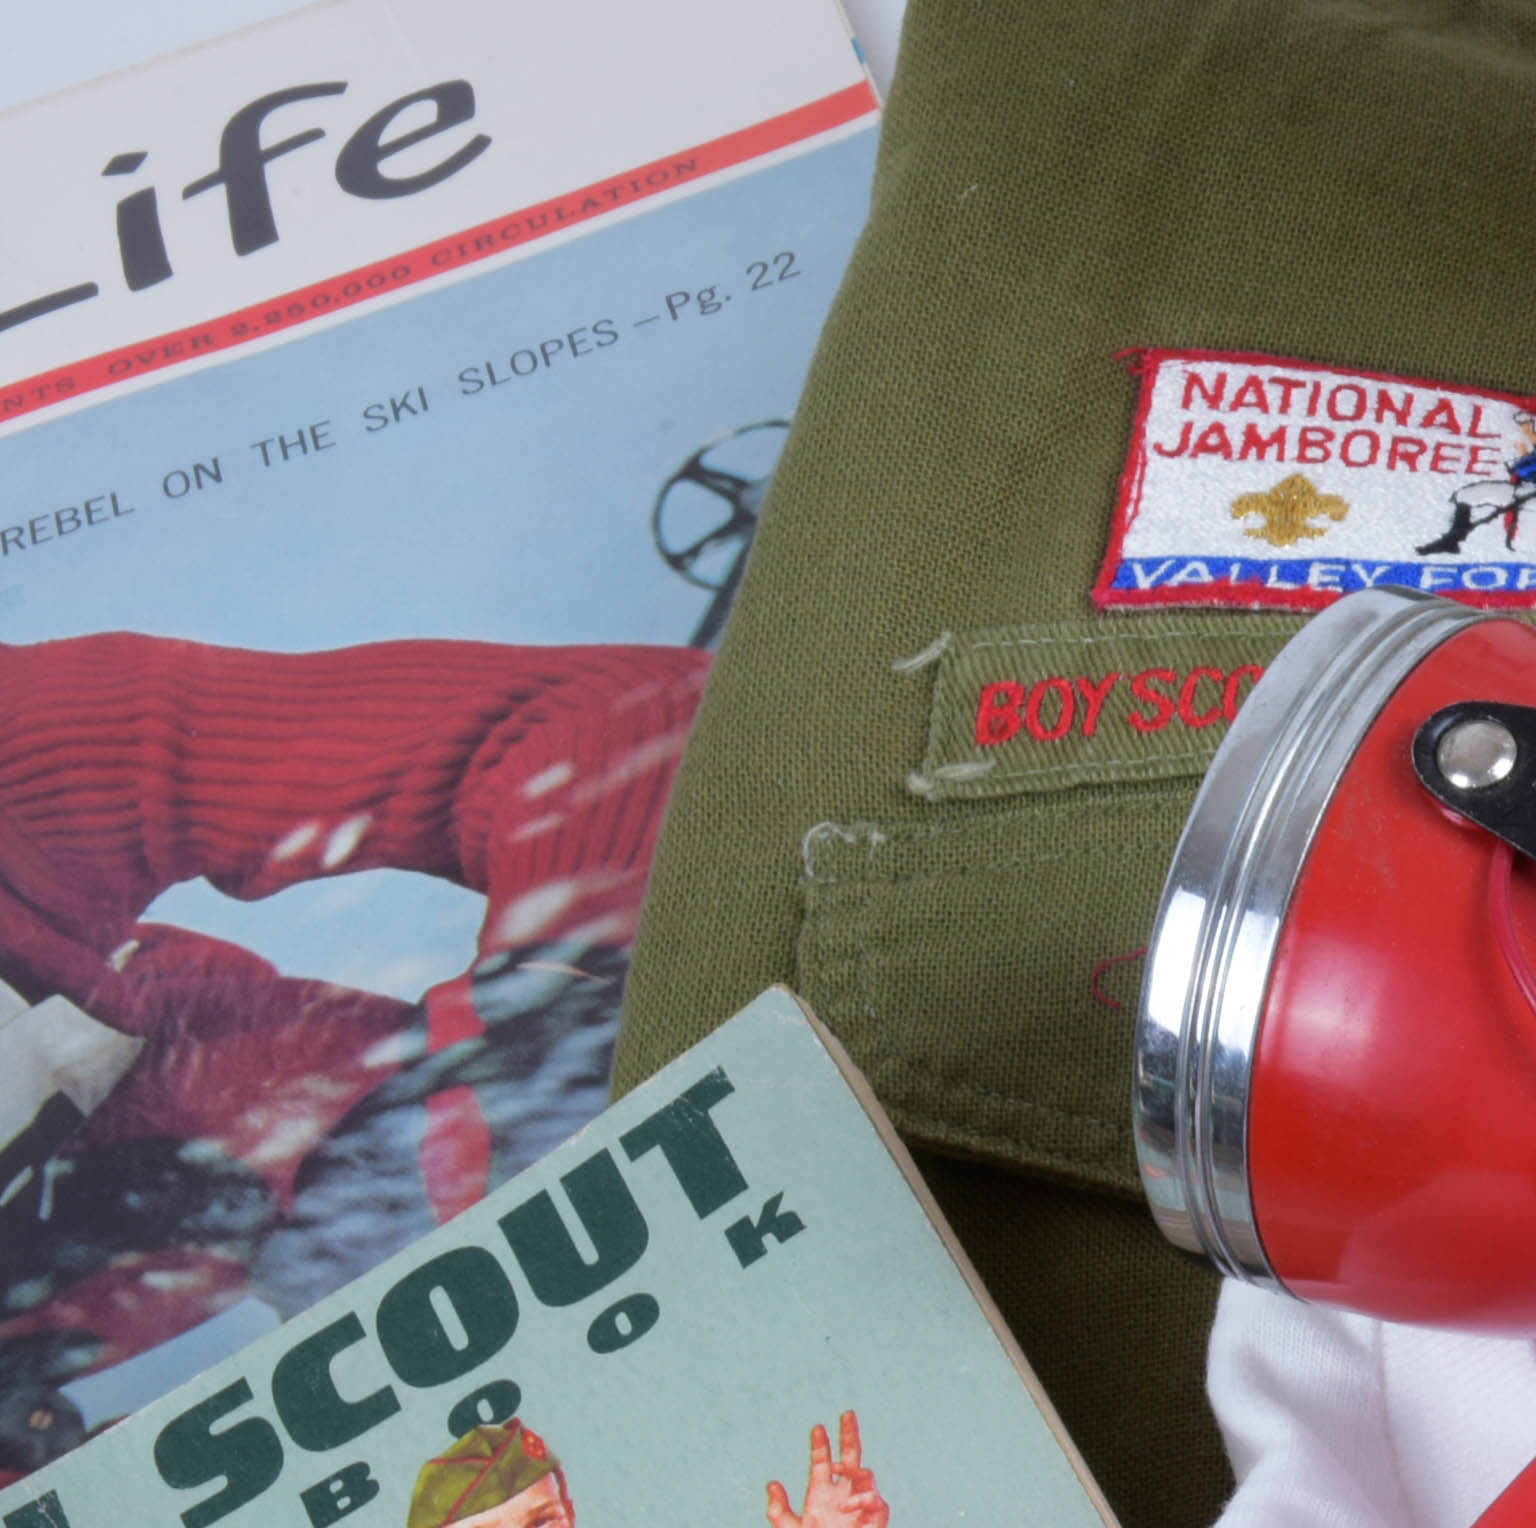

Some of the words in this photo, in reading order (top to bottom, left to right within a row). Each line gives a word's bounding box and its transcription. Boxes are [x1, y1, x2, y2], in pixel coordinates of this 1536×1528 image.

[0, 79, 492, 331] ife
[107, 331, 215, 377] OVER
[431, 156, 699, 267] CIRCULATION
[0, 491, 135, 556] REBEL
[162, 457, 224, 500] ON
[250, 419, 337, 468] THE
[362, 385, 431, 434] SKI
[456, 318, 620, 397] SLOPES
[745, 251, 801, 292] 22
[1180, 370, 1502, 440] NATIONAL
[1153, 420, 1504, 477] JAMBOREE
[1131, 558, 1391, 592] VALLEY
[975, 672, 1121, 746] BOY
[1127, 663, 1268, 734] SCO
